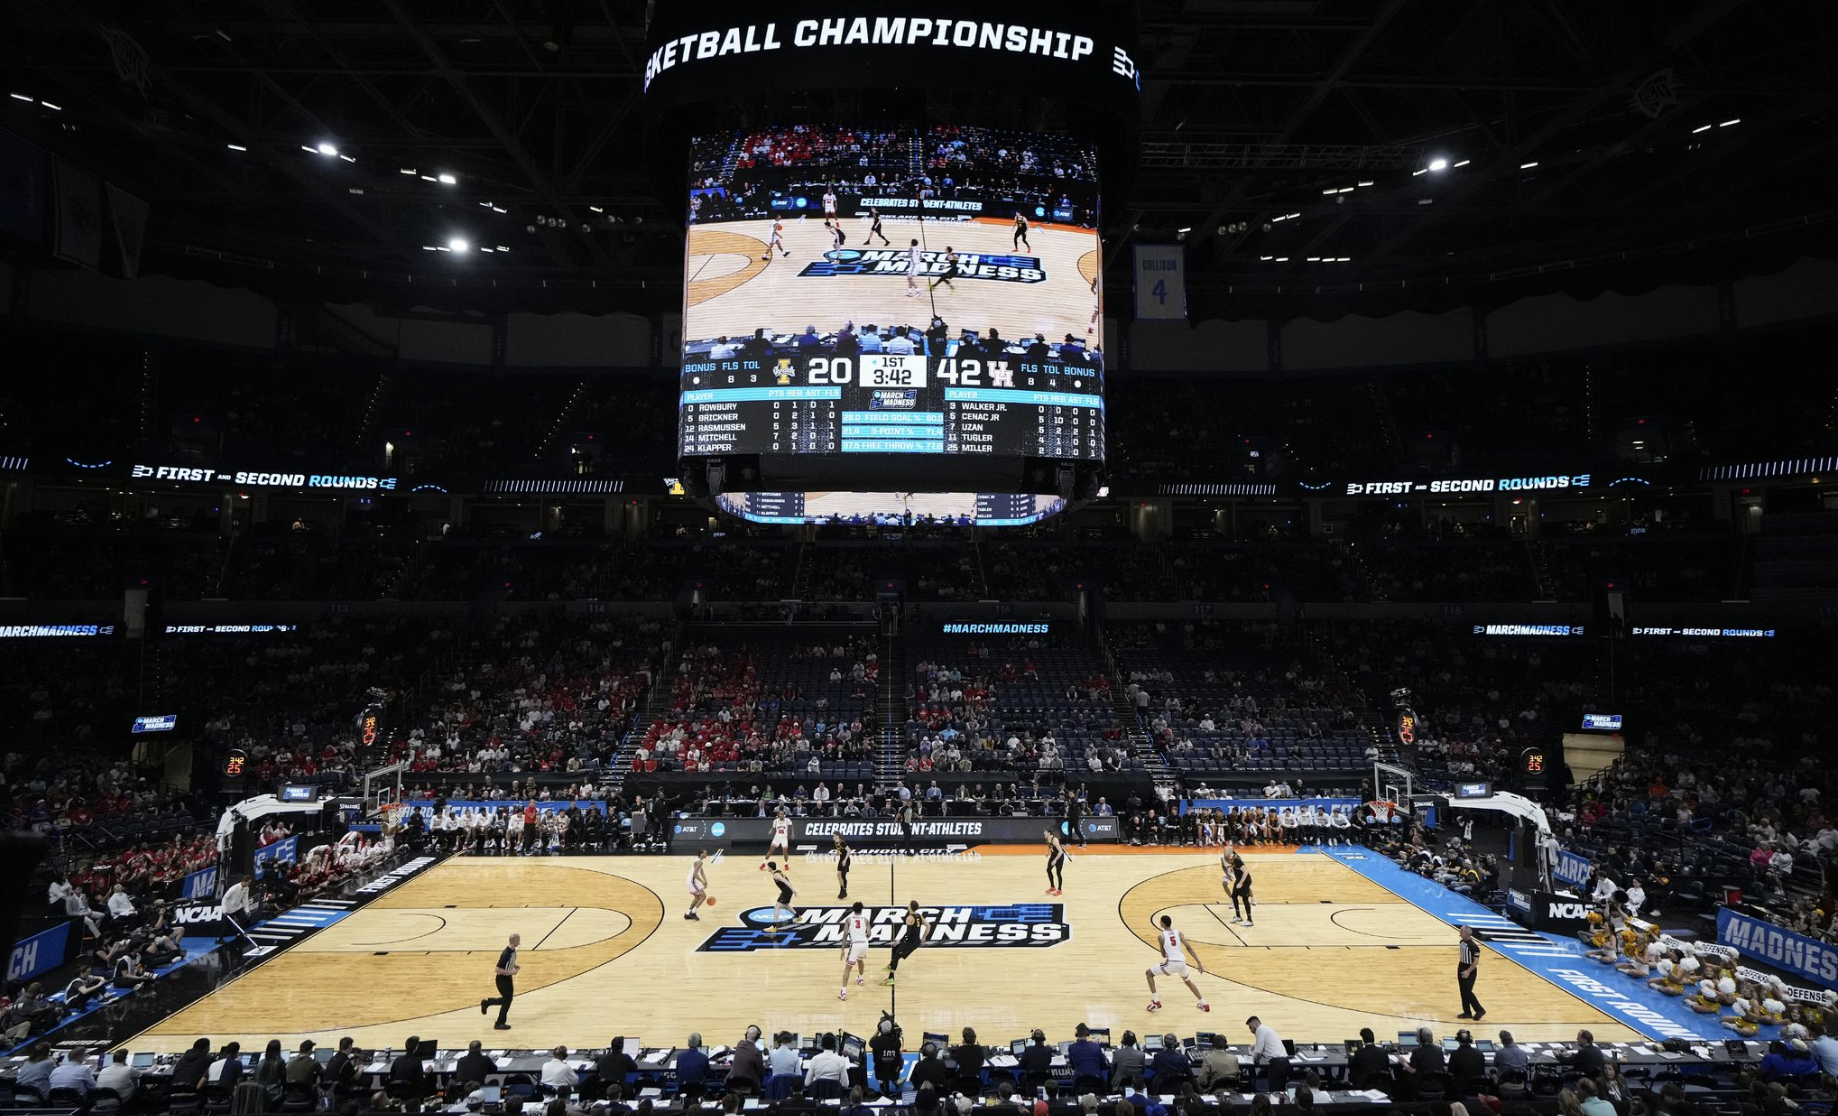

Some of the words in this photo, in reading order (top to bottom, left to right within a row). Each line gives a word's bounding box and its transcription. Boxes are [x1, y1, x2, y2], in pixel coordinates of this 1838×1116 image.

[794, 17, 1094, 61] CHAMPIONSHIP
[860, 197, 908, 208] CELEBRATES
[1152, 279, 1167, 305] 4
[685, 362, 716, 373] BONUS
[722, 361, 739, 371] FLS
[743, 360, 760, 370] TOL
[882, 357, 905, 367] 1ST
[808, 357, 852, 384] 20
[937, 359, 981, 385] 42
[1021, 363, 1038, 373] FLS
[1043, 365, 1060, 375] TOL
[1064, 366, 1095, 377] BONUS
[750, 374, 757, 382] 3
[873, 369, 912, 384] 3:42
[1050, 378, 1056, 386] 4
[687, 392, 713, 400] PLAYER
[824, 388, 839, 396] FLS
[880, 391, 904, 399] MARCH
[949, 390, 978, 398] PLAYER
[1034, 394, 1048, 402] PTS
[1050, 395, 1066, 403] REB
[1068, 396, 1083, 404] AST
[1086, 397, 1098, 405] FLS
[699, 403, 738, 412] ROWBURY
[882, 399, 914, 407] MADNESS
[962, 402, 994, 411] WALKER
[698, 414, 738, 422] BRICKNER
[962, 413, 988, 421] CENAC
[990, 413, 1000, 421] JR
[698, 423, 746, 432] RASMUSSEN
[962, 424, 983, 432] UZAN
[698, 434, 737, 442] MITCHELL
[962, 434, 993, 442] TUGLER
[698, 444, 732, 452] KLAPPER
[962, 444, 992, 452] MILLER
[156, 466, 216, 482] FIRST
[235, 472, 306, 486] SECOND
[309, 474, 380, 489] ROUNDS
[1365, 481, 1414, 494] FIRST
[1430, 480, 1495, 493] SECOND
[1498, 476, 1570, 490] ROUNDS
[942, 624, 1049, 634] #MARCHMADNESS
[1486, 624, 1571, 636] MARCHMADNESS
[1644, 627, 1672, 636] FIRST
[1682, 628, 1721, 636] SECOND
[1722, 629, 1764, 638] ROUNDS
[145, 722, 174, 730] MADNESS
[1593, 720, 1621, 728] MADNESS
[228, 764, 241, 774] 25
[1528, 762, 1541, 771] 25
[804, 822, 874, 836] CELEBRATES
[1097, 824, 1112, 832] AT&T
[172, 906, 222, 923] NCAA
[856, 920, 861, 928] 3
[1170, 936, 1176, 946] 5
[1547, 968, 1631, 1000] FIRST
[1788, 988, 1827, 1002] DEFENSE
